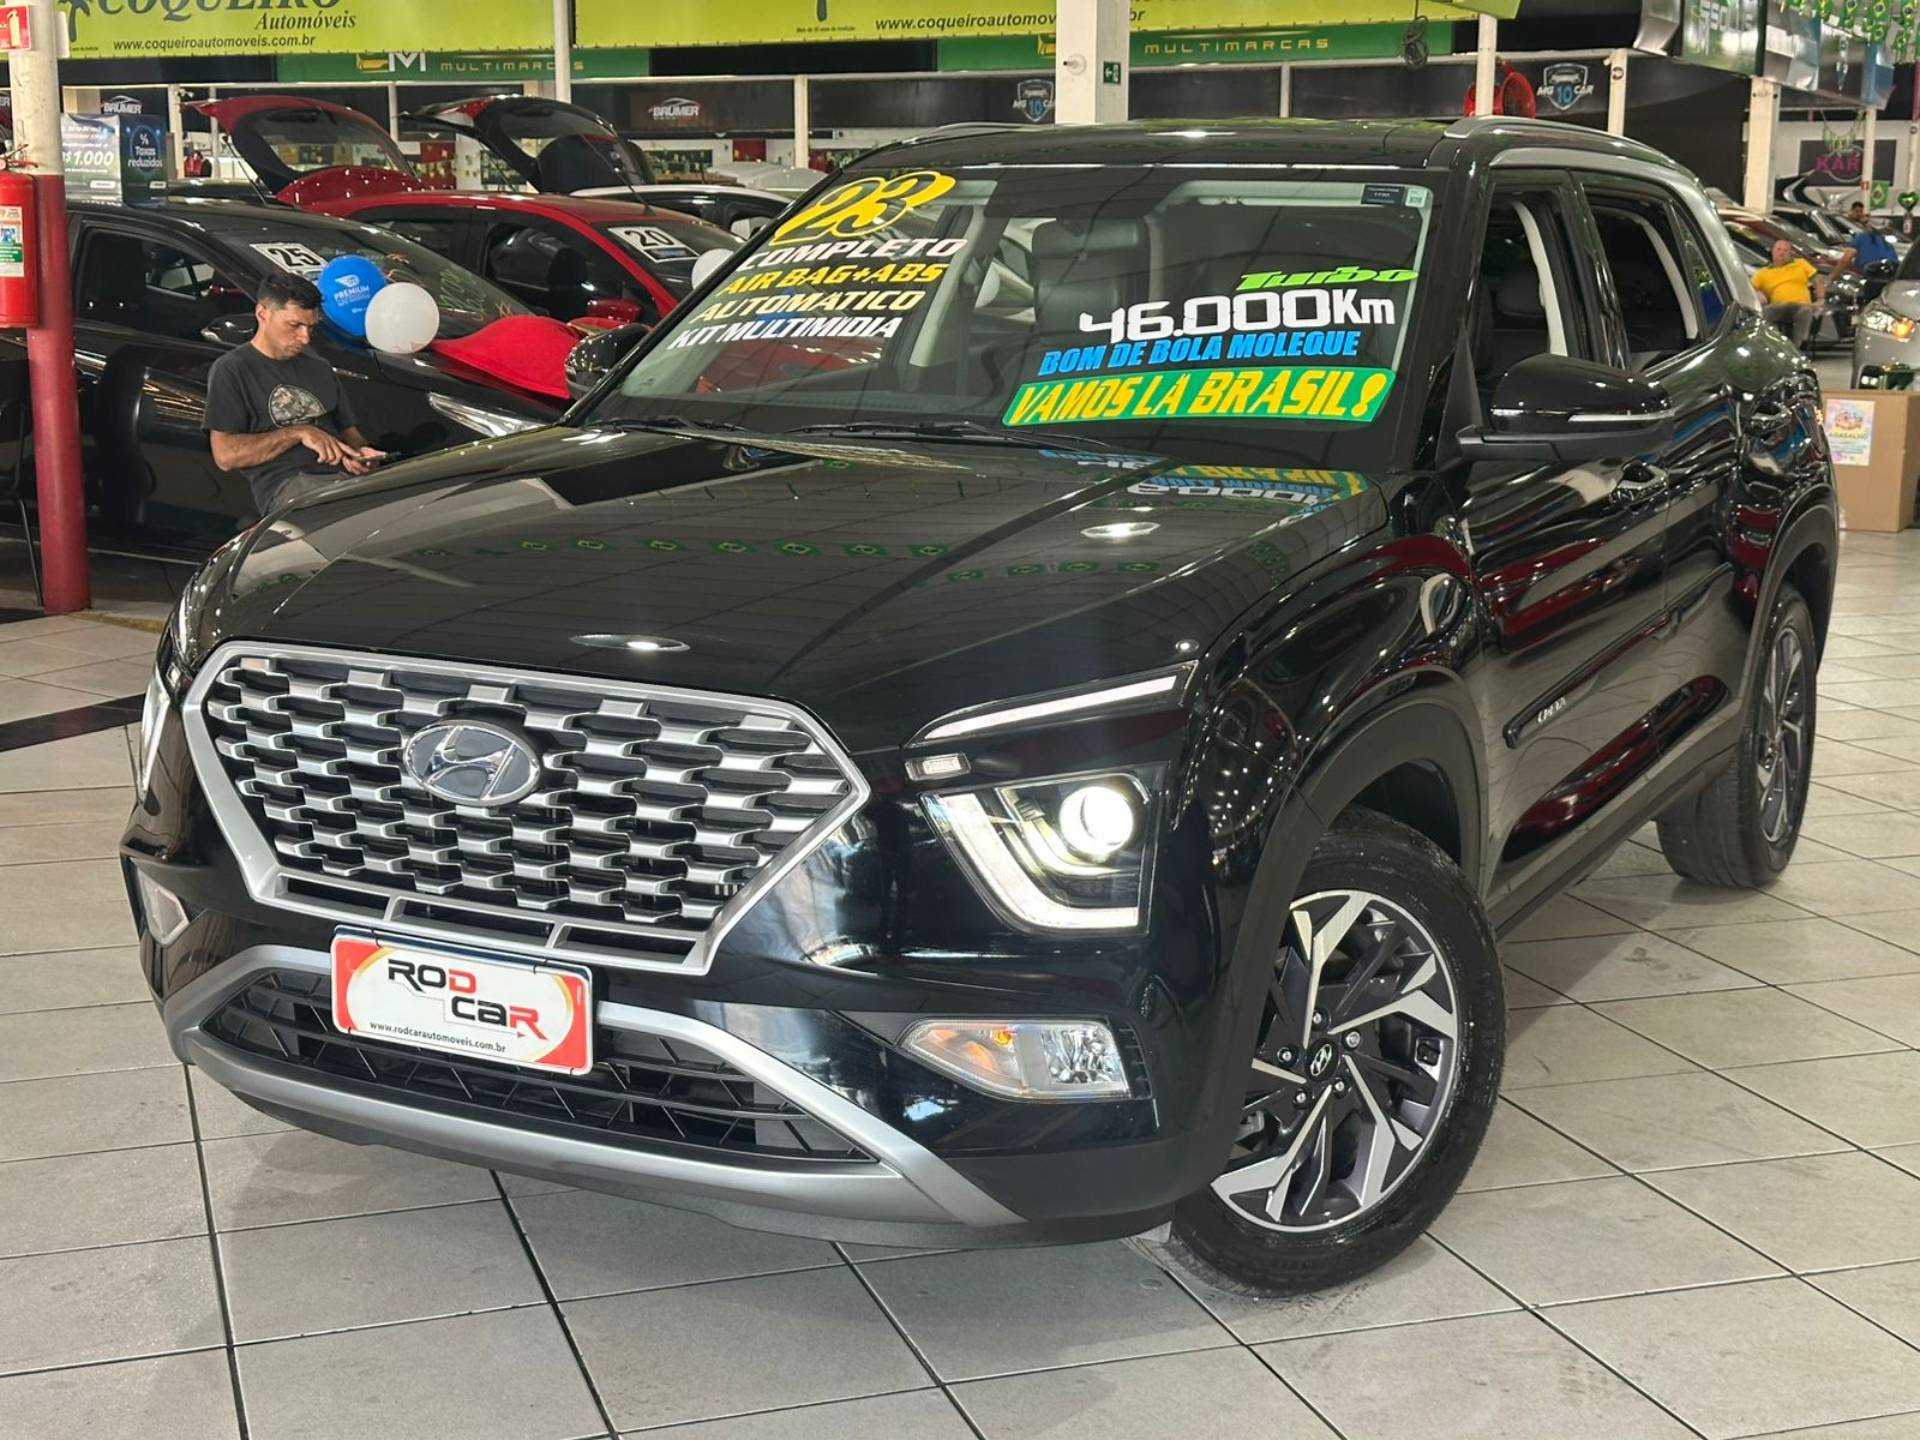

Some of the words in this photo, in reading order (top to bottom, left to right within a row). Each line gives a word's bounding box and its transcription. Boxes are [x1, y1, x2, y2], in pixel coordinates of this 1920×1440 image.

[254, 10, 357, 30] Automóveis
[113, 34, 315, 51] www.coqueiroautomoveis.com.br
[1144, 38, 1330, 54] MULTIMARCAS
[440, 60, 585, 72] MULTIMARCS
[1556, 85, 1574, 103] 10
[1573, 84, 1596, 96] CAR
[769, 171, 956, 246] 23
[624, 229, 675, 248] 20
[267, 248, 322, 267] 25
[736, 239, 967, 272] COMPLETO
[716, 271, 783, 298] AIR
[1235, 266, 1419, 291] Turbo
[1079, 289, 1396, 344] 46.000Km
[666, 323, 726, 351] KIT
[1038, 345, 1106, 376] BOM
[1108, 341, 1146, 368] DE
[1148, 336, 1223, 364] BOLA
[1226, 330, 1362, 357] MOLEQUE
[1009, 376, 1143, 424] VAMOS
[369, 1020, 507, 1054] www.rodcarautomoveis.com.br
